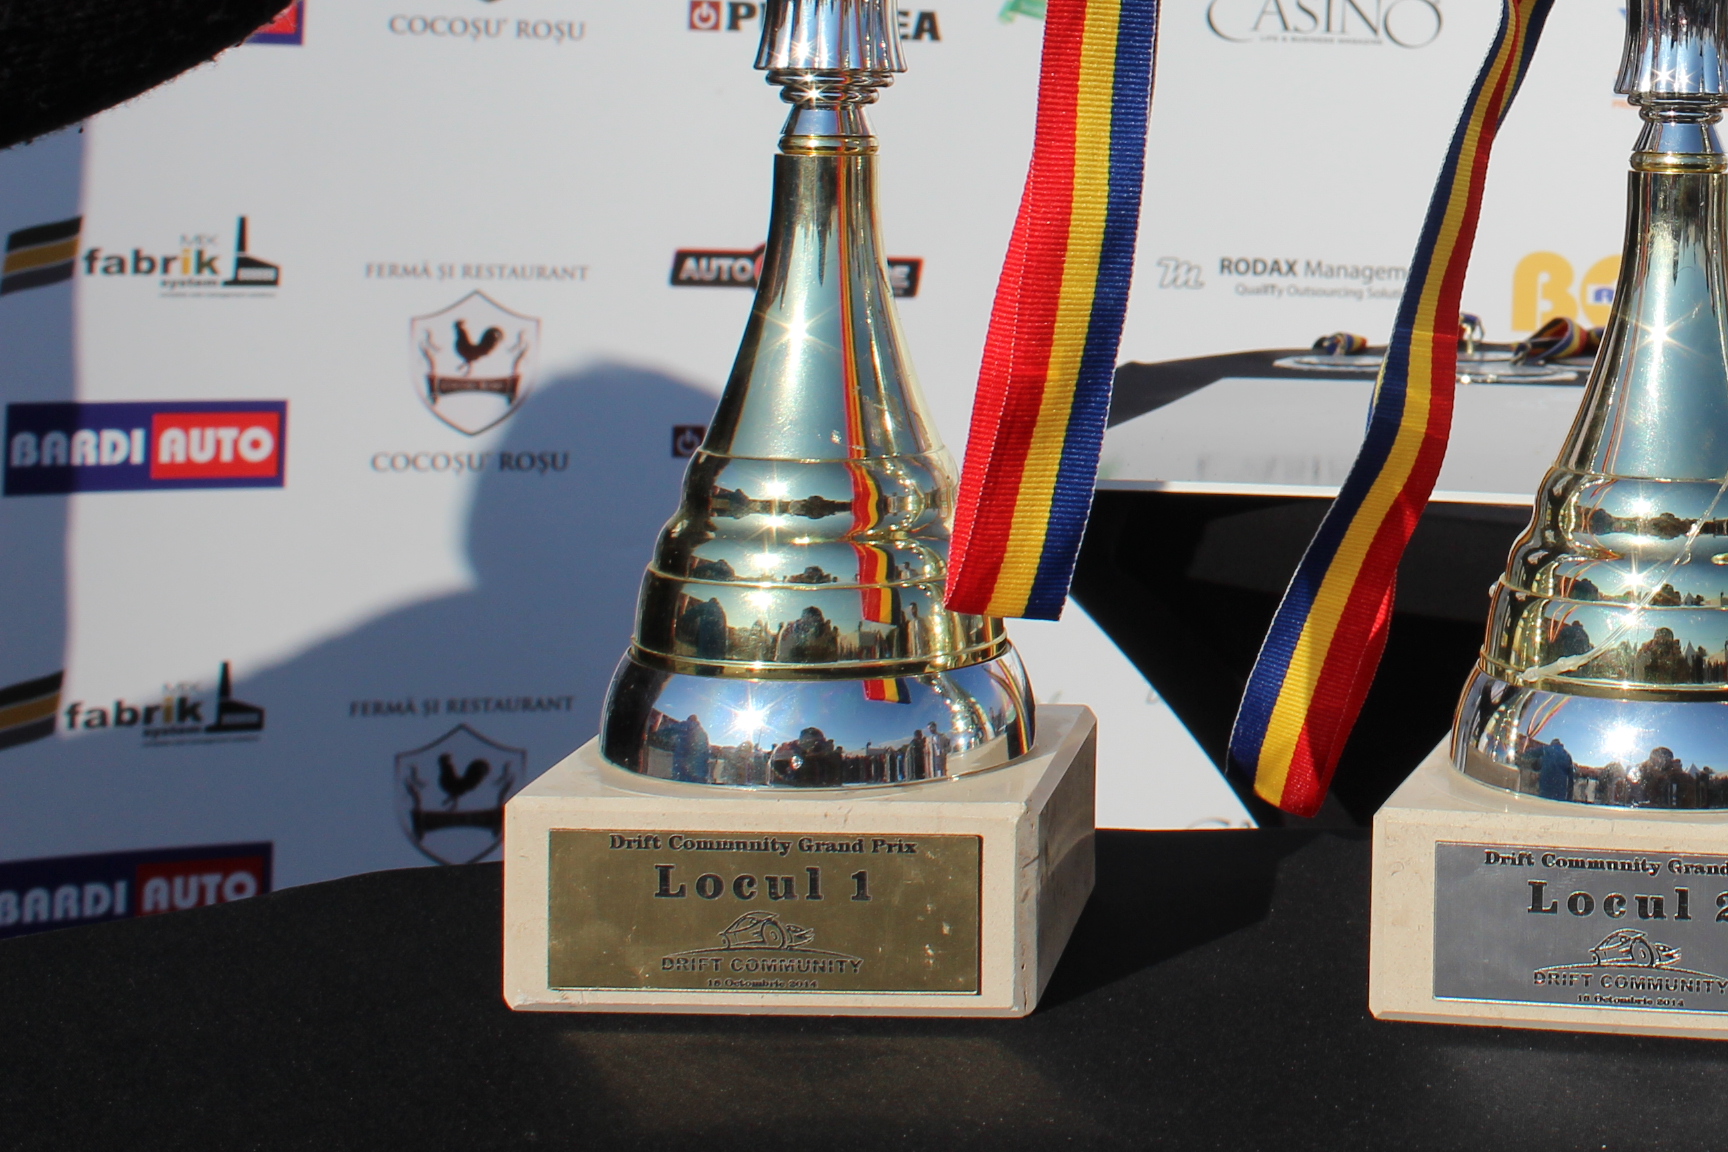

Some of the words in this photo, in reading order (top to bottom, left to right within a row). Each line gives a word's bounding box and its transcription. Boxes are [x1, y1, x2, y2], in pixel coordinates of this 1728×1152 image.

[84, 247, 223, 277] fabrik
[461, 261, 591, 282] RESTAURANT
[1219, 256, 1299, 278] RODAX
[1304, 259, 1410, 286] Managem
[10, 427, 146, 468] BARDI
[158, 425, 276, 464] AUTO
[66, 695, 204, 729] fabrik
[609, 834, 662, 851] Drift
[668, 835, 793, 857] Community
[798, 837, 865, 855] Grand
[871, 838, 918, 856] Prix
[1484, 849, 1535, 867] Drift
[1541, 853, 1663, 877] Community
[653, 863, 824, 902] Locul
[849, 869, 873, 903] 1
[0, 879, 130, 927] BARDI
[141, 871, 259, 912] AUTO
[1527, 879, 1693, 923] Locul
[661, 957, 724, 973] DRIFT
[730, 957, 865, 975] COMMUNITY
[1533, 971, 1595, 988] DRIFT
